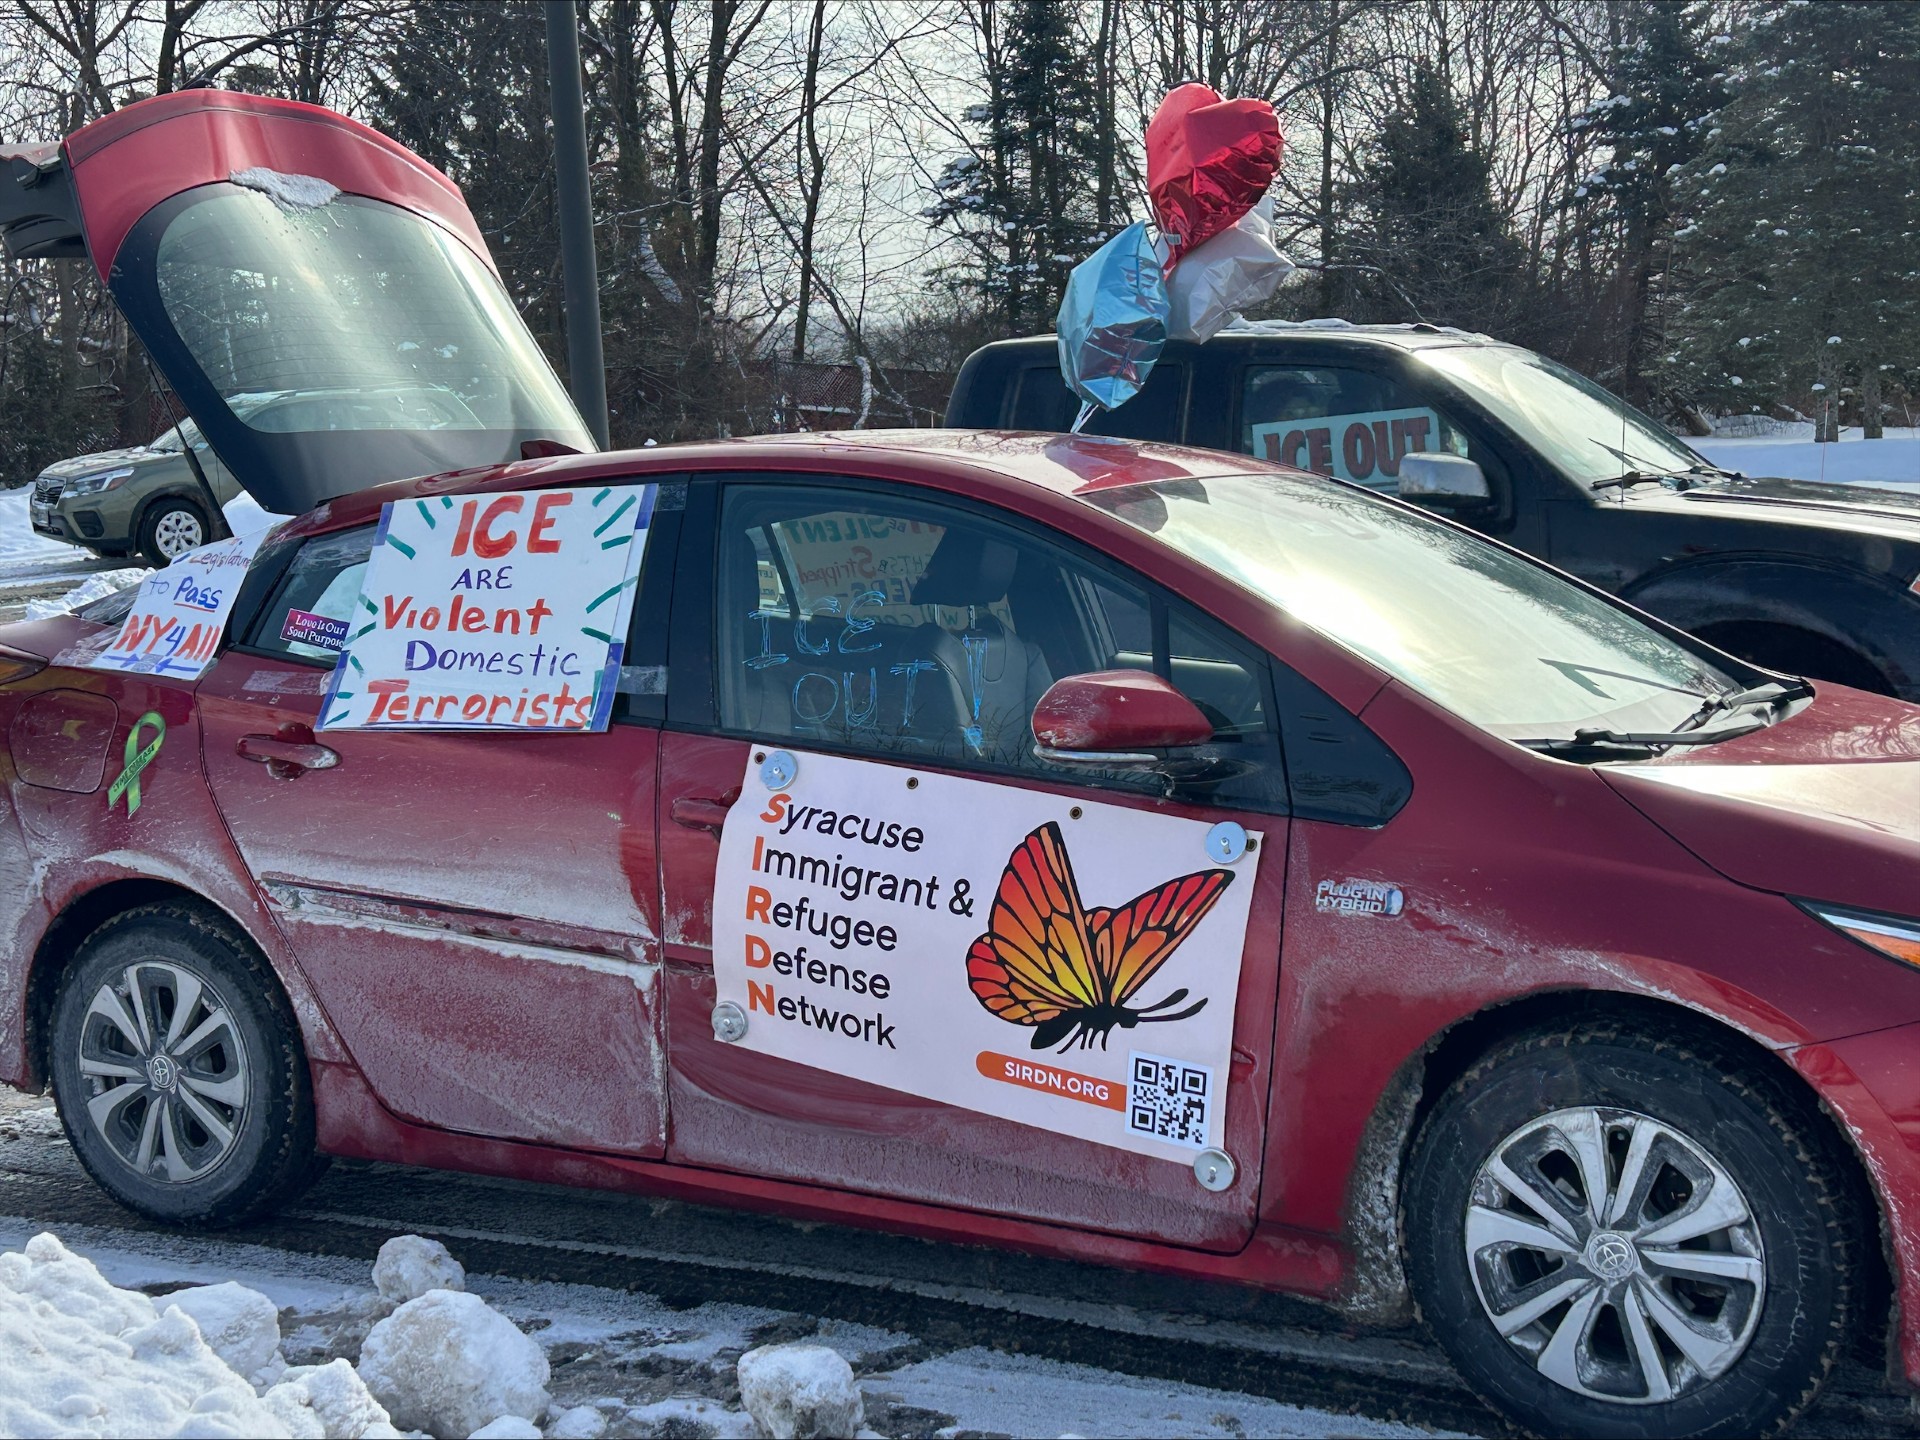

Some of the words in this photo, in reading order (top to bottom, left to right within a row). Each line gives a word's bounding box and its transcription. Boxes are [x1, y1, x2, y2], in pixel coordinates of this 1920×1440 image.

[1263, 427, 1334, 477] ICE
[1343, 416, 1430, 480] OUT
[451, 492, 574, 559] ICE
[150, 574, 170, 595] to
[173, 576, 222, 609] Pass
[450, 566, 513, 590] ARE
[113, 614, 221, 663] NY4All
[287, 626, 308, 639] Soul
[308, 631, 344, 648] Purpose
[296, 615, 317, 629] Love
[317, 620, 326, 630] Is
[326, 622, 345, 635] Our
[384, 594, 554, 635] Violent
[742, 590, 886, 669] ICE
[405, 640, 582, 676] Domestic
[366, 679, 593, 728] Terrorists
[760, 793, 924, 852] Syracuse
[751, 836, 940, 910] Immigrant
[948, 878, 974, 918] &
[745, 885, 898, 952] Refugee
[1315, 894, 1382, 913] HYBRID
[745, 934, 891, 999] Defense
[747, 979, 897, 1049] Network
[1004, 1061, 1110, 1101] SIRDN.ORG
